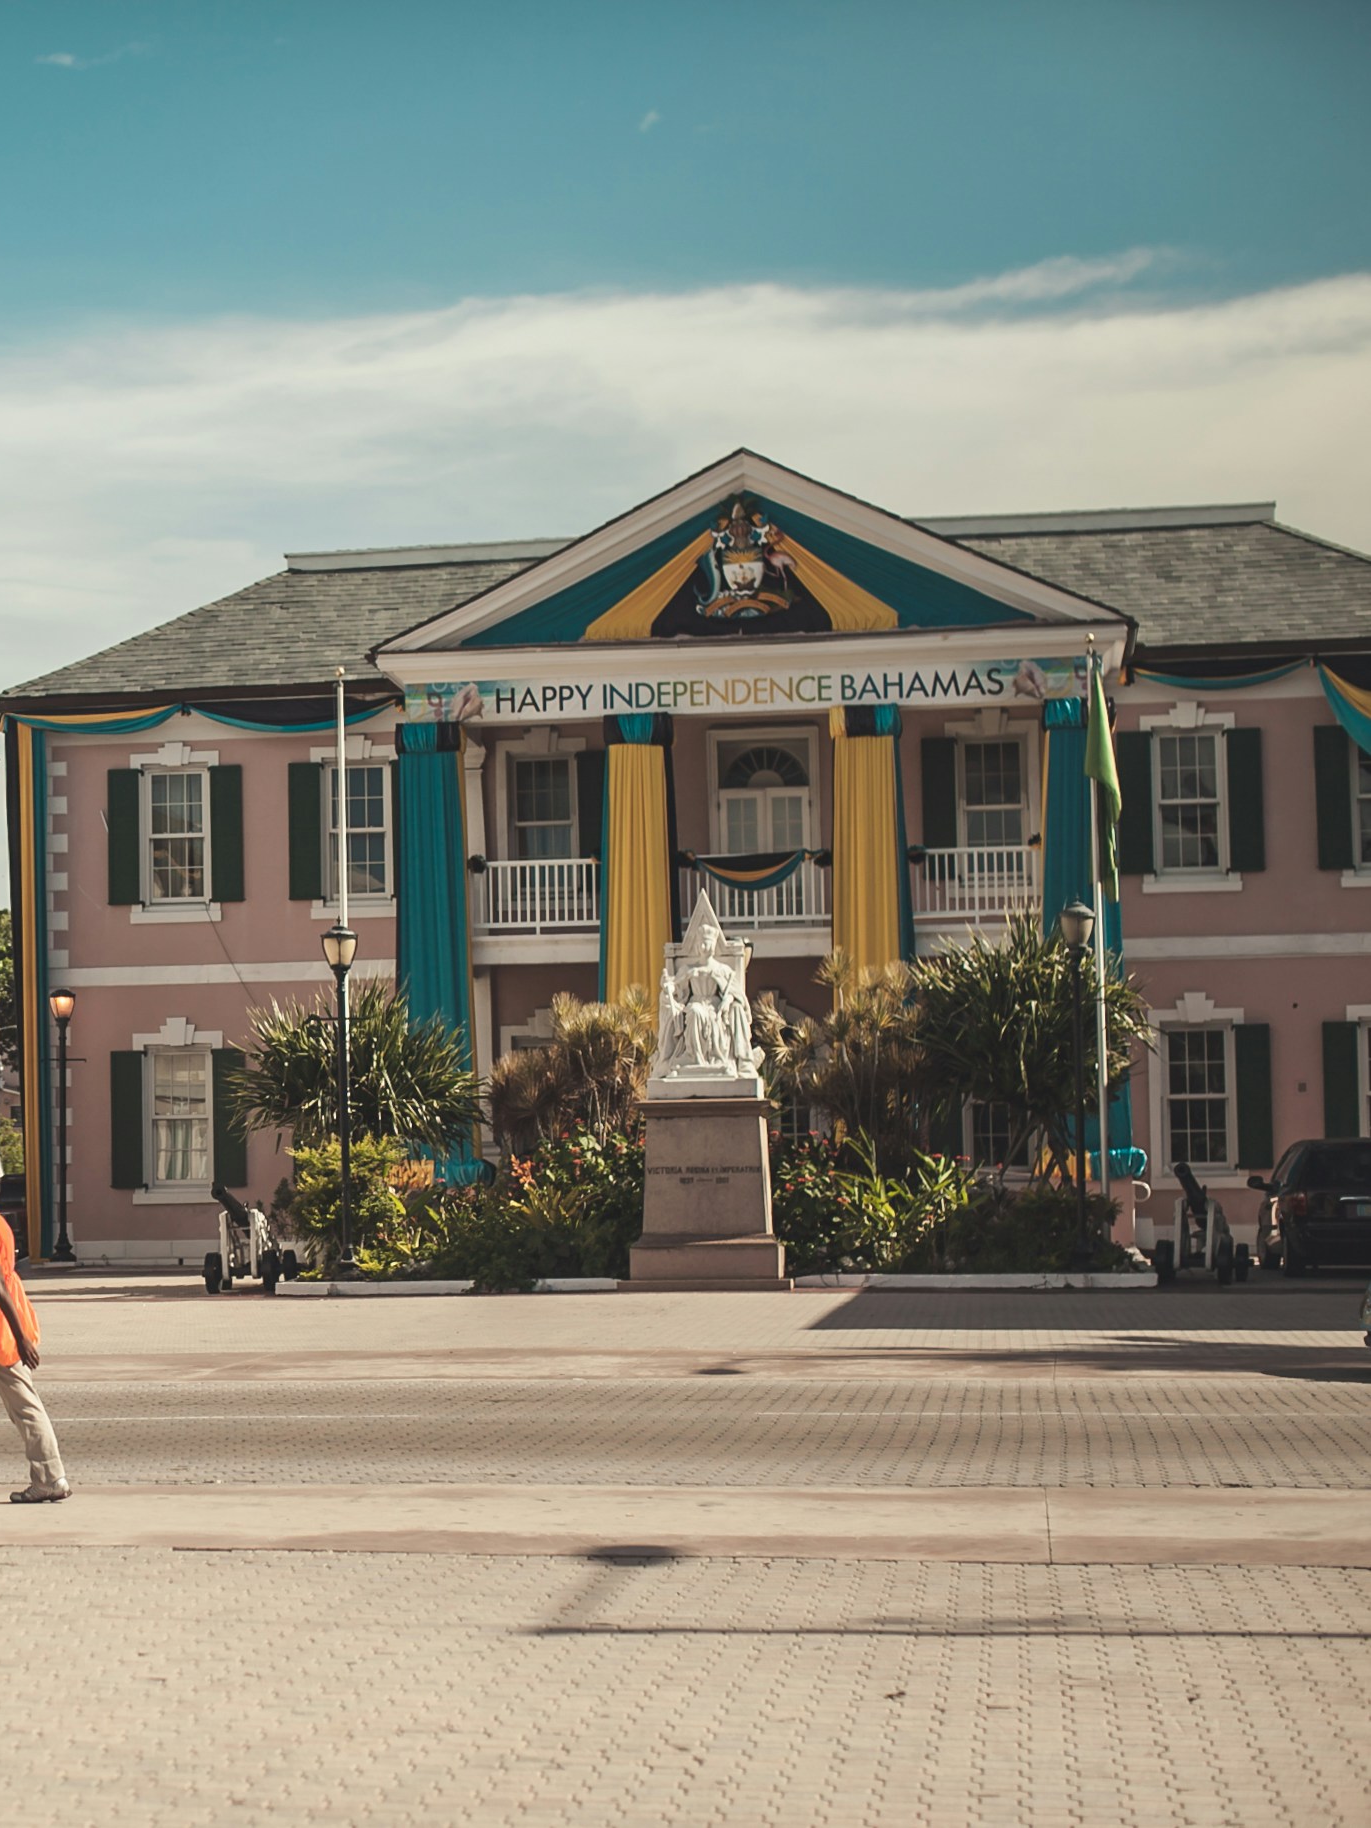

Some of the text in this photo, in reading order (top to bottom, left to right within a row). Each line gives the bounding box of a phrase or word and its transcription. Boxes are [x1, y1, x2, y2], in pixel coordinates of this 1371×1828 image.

[496, 667, 1005, 714] HAPPY INDEPENDENCE BAHAMAS
[647, 1166, 683, 1175] VICTORIA
